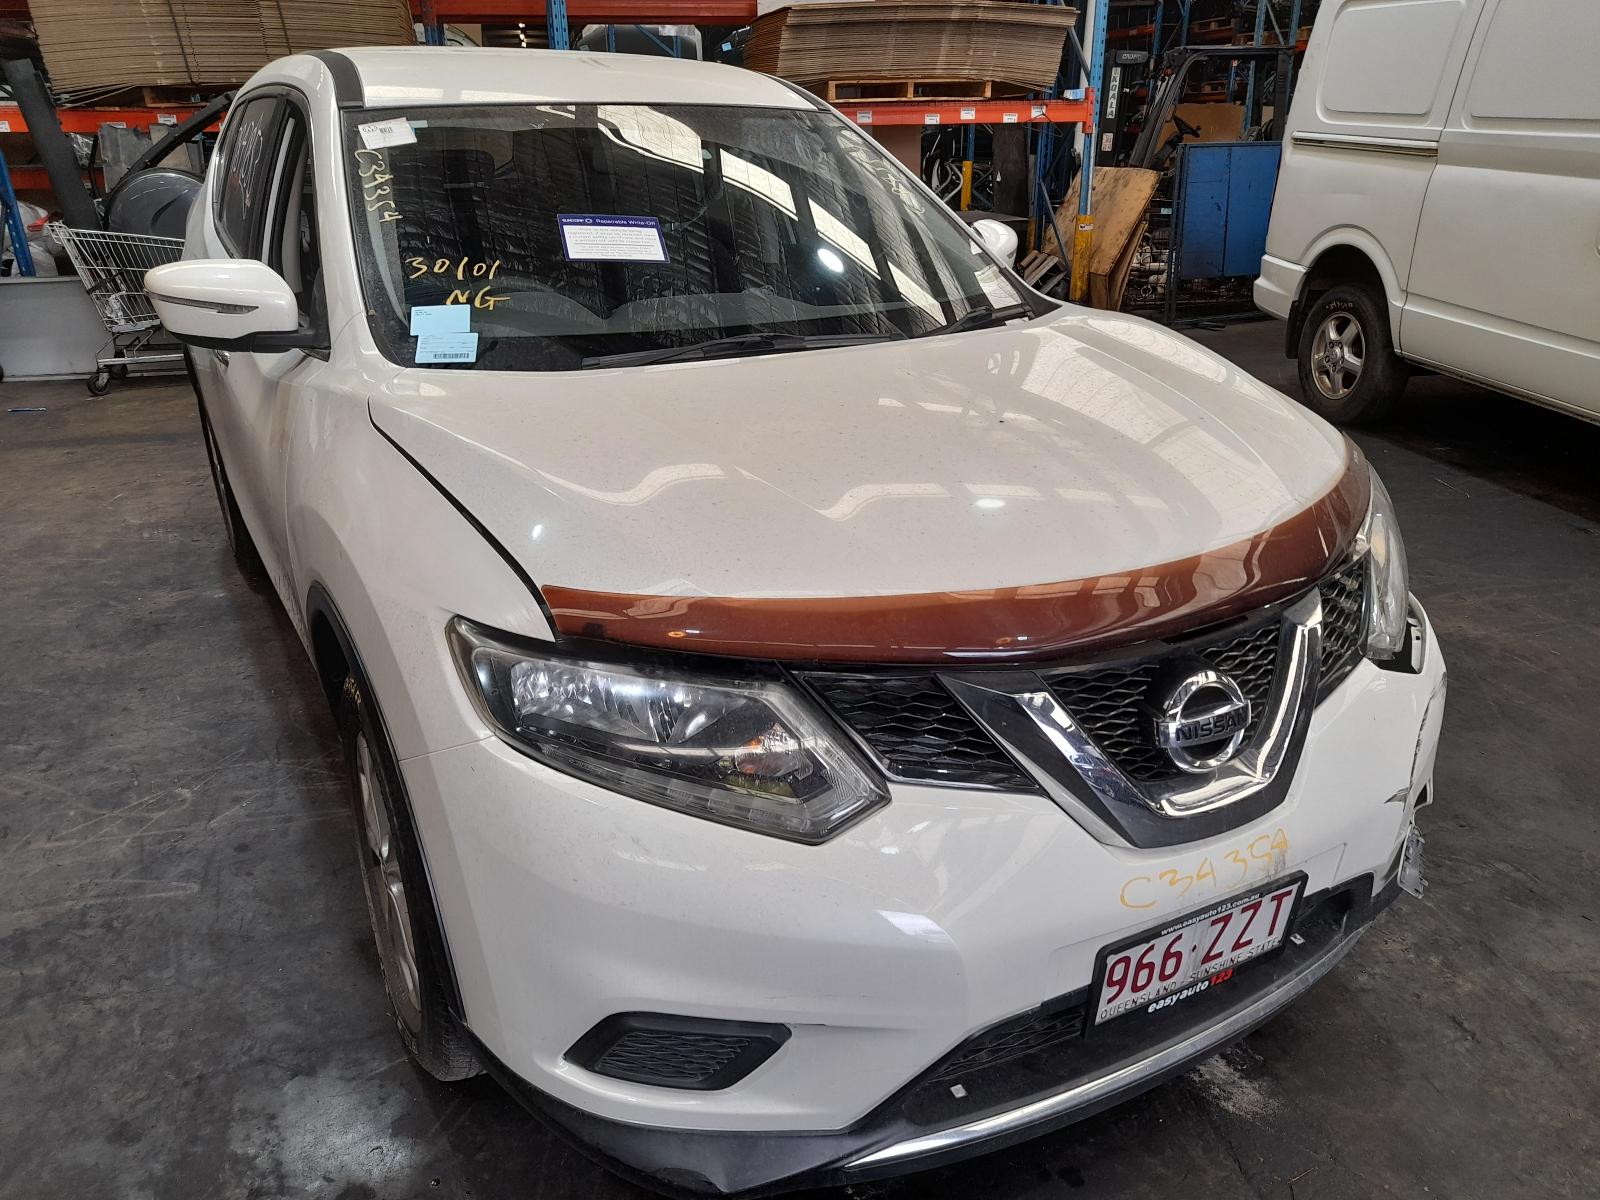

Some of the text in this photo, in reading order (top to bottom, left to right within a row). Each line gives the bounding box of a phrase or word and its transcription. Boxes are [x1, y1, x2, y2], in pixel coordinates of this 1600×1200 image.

[446, 286, 511, 311] NG
[1175, 708, 1248, 742] NISSAN
[1160, 893, 1261, 937] www.easyauto123.com.au
[1100, 936, 1282, 1020] QUEENSLAND SUNSHINE STATE
[1147, 967, 1233, 1014] easyauto123
